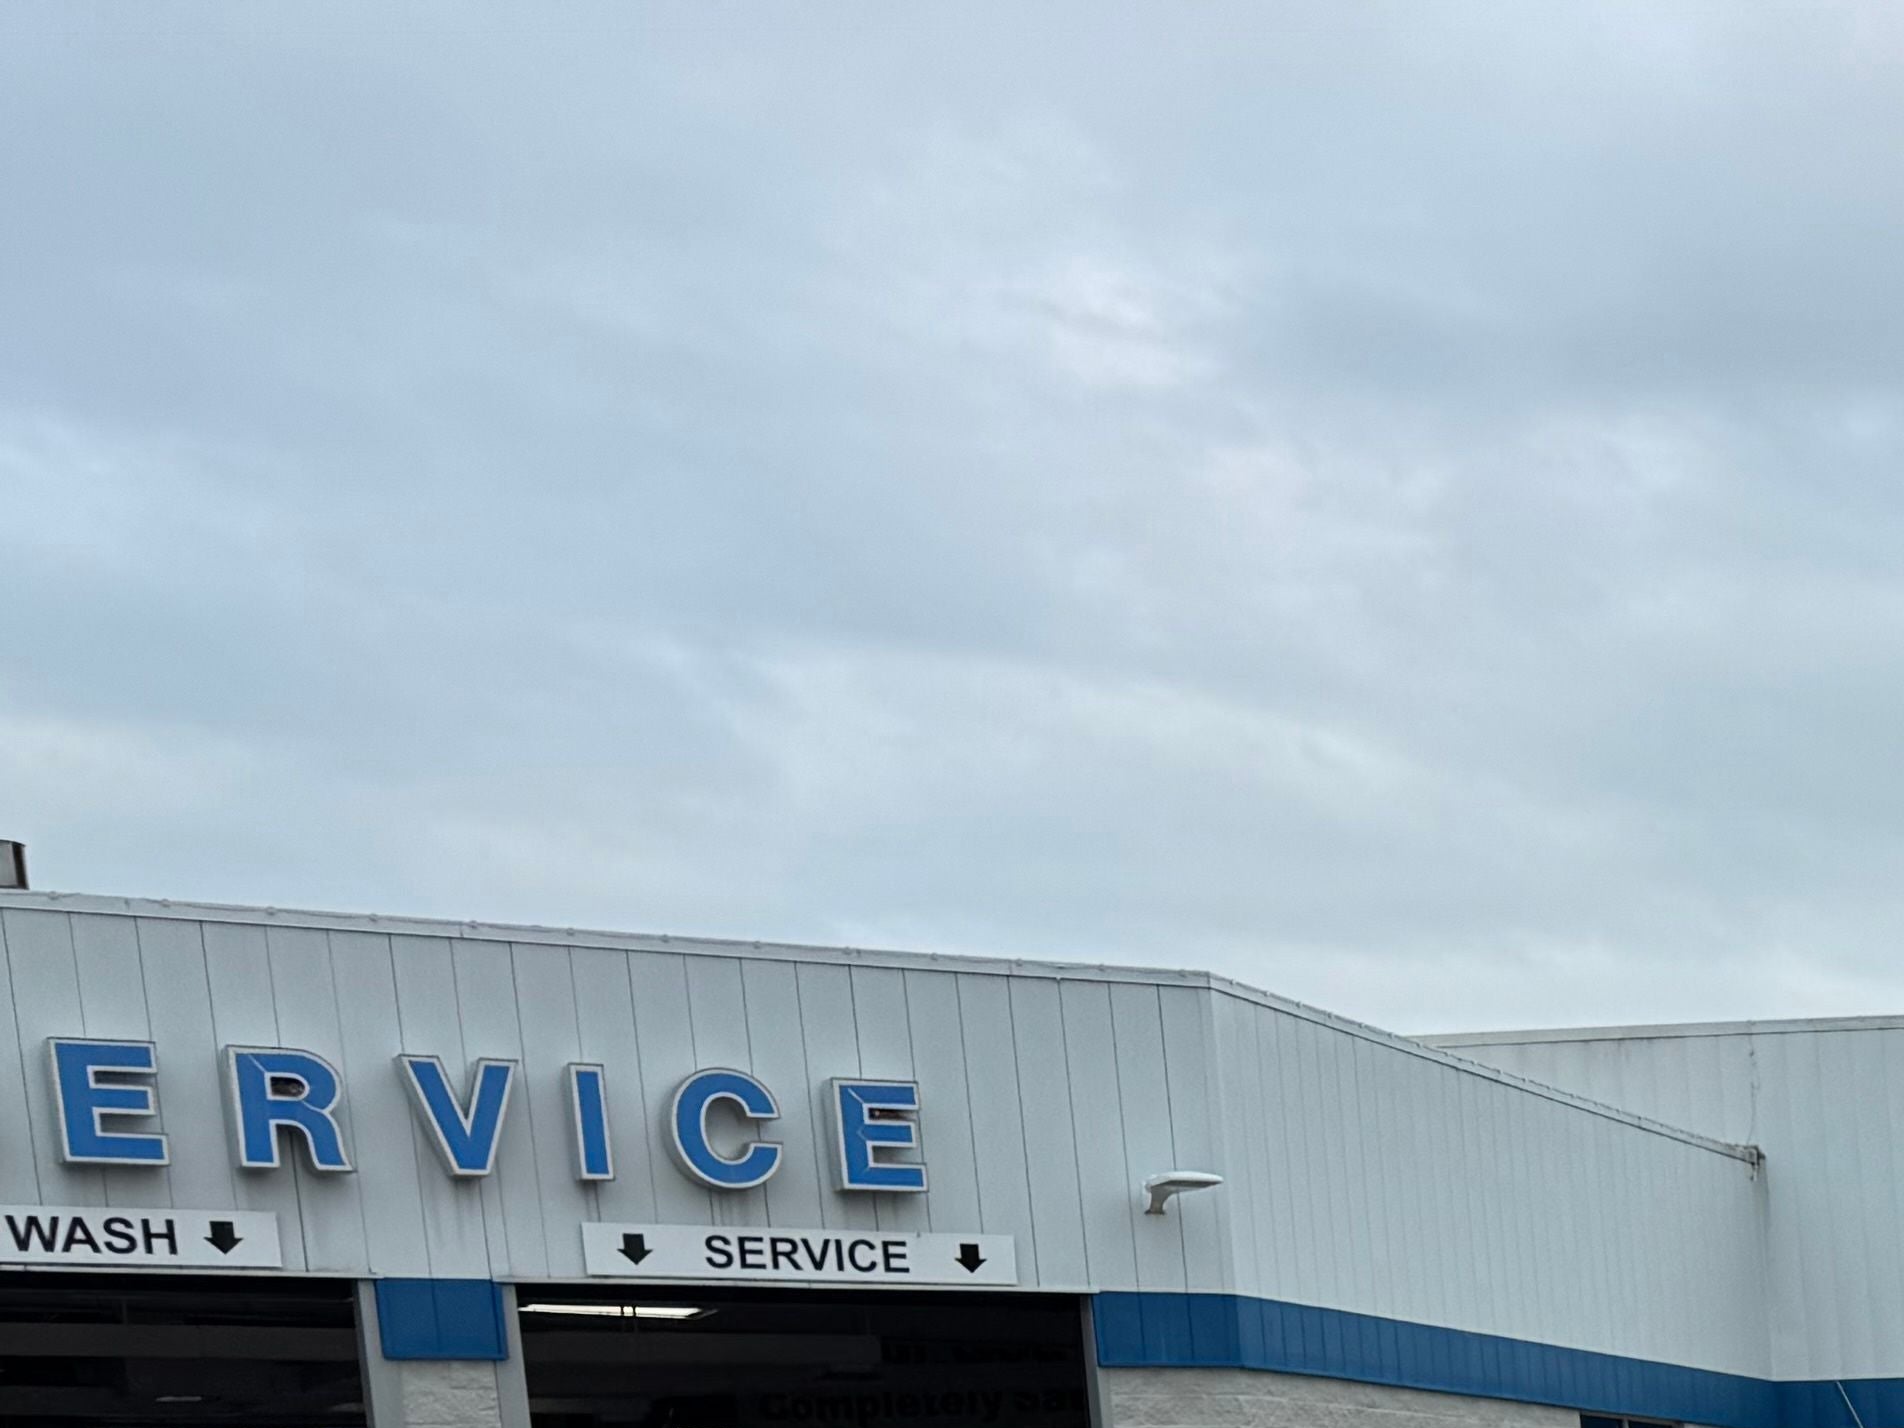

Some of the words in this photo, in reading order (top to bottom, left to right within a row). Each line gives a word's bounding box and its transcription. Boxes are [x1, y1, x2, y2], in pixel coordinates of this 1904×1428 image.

[47, 1037, 929, 1193] ERVICE
[5, 1215, 178, 1256] WASH
[704, 1234, 910, 1274] SERVICE
